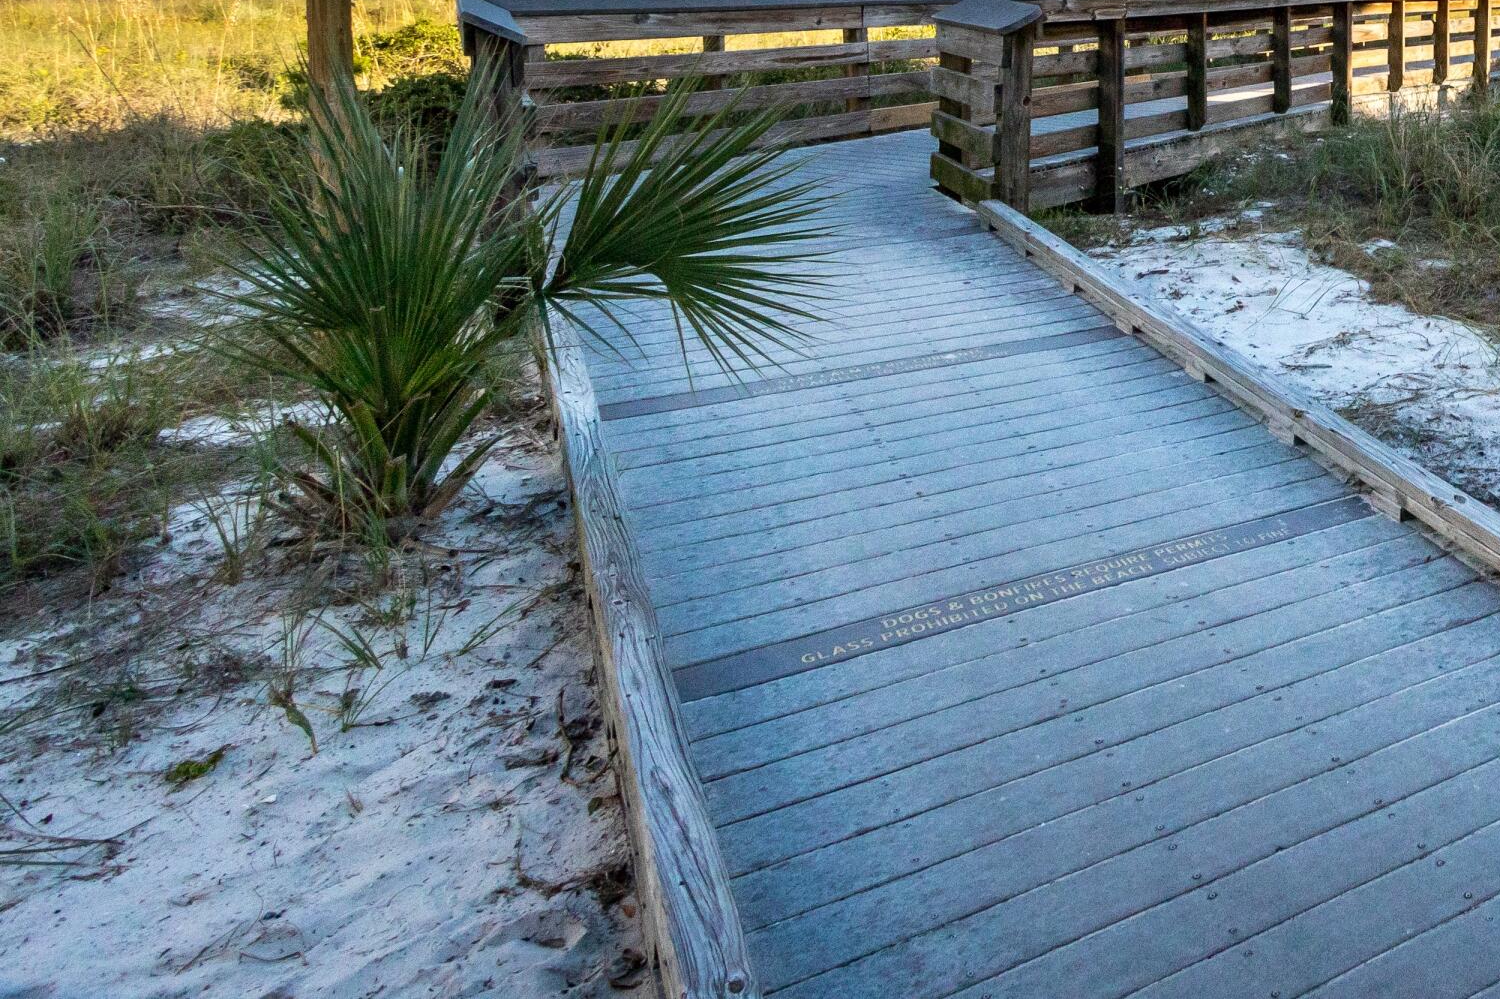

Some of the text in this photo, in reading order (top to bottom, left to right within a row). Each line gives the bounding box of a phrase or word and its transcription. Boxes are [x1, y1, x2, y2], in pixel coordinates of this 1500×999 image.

[800, 637, 874, 664] GLASS
[880, 600, 1009, 642] PROHIBITED
[1014, 591, 1044, 605] ON
[1051, 581, 1089, 596] THE
[1092, 564, 1154, 584] BEACH
[1162, 543, 1230, 566] SUBJECT
[882, 532, 1228, 629] DOGS & BONFIRES REQUIRE PERMITS
